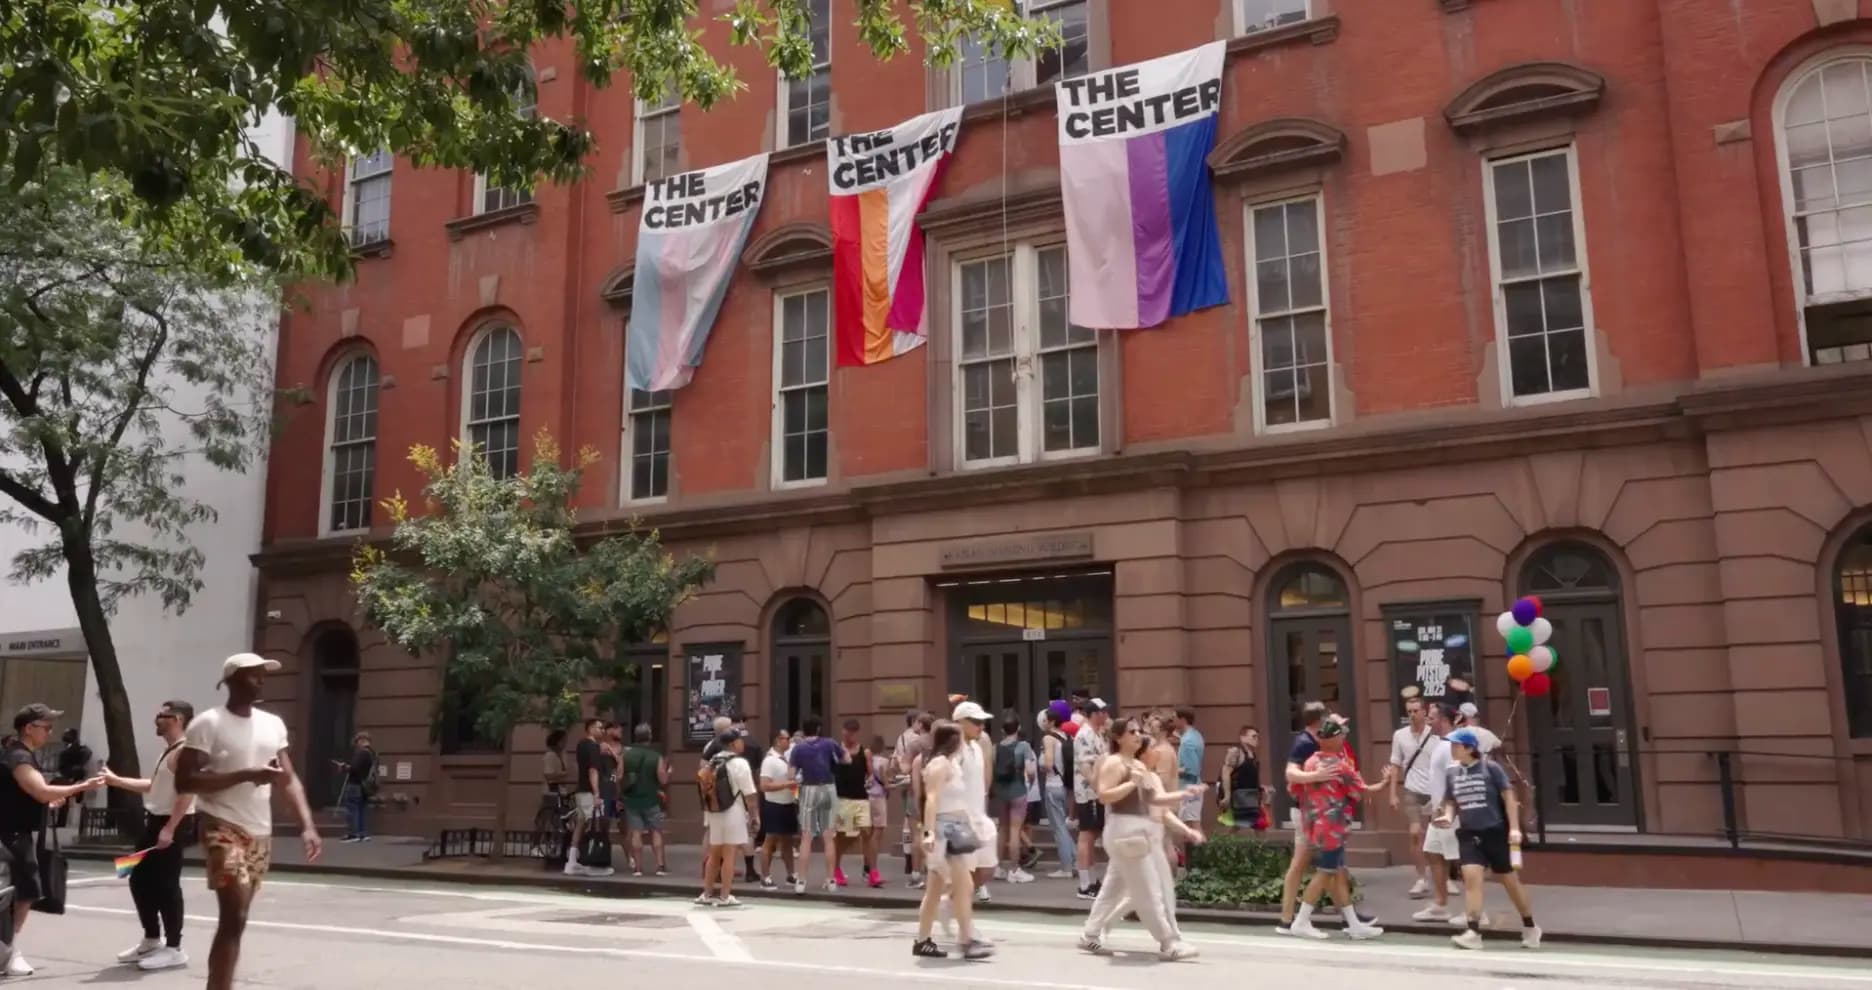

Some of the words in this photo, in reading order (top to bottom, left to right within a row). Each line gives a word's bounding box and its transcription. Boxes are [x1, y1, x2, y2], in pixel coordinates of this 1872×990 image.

[1062, 69, 1140, 106] THE
[1066, 78, 1221, 139] CENTER
[832, 130, 893, 157] THE
[650, 172, 706, 200] THE
[644, 181, 760, 228] CENTER
[1420, 649, 1444, 665] PRIDE
